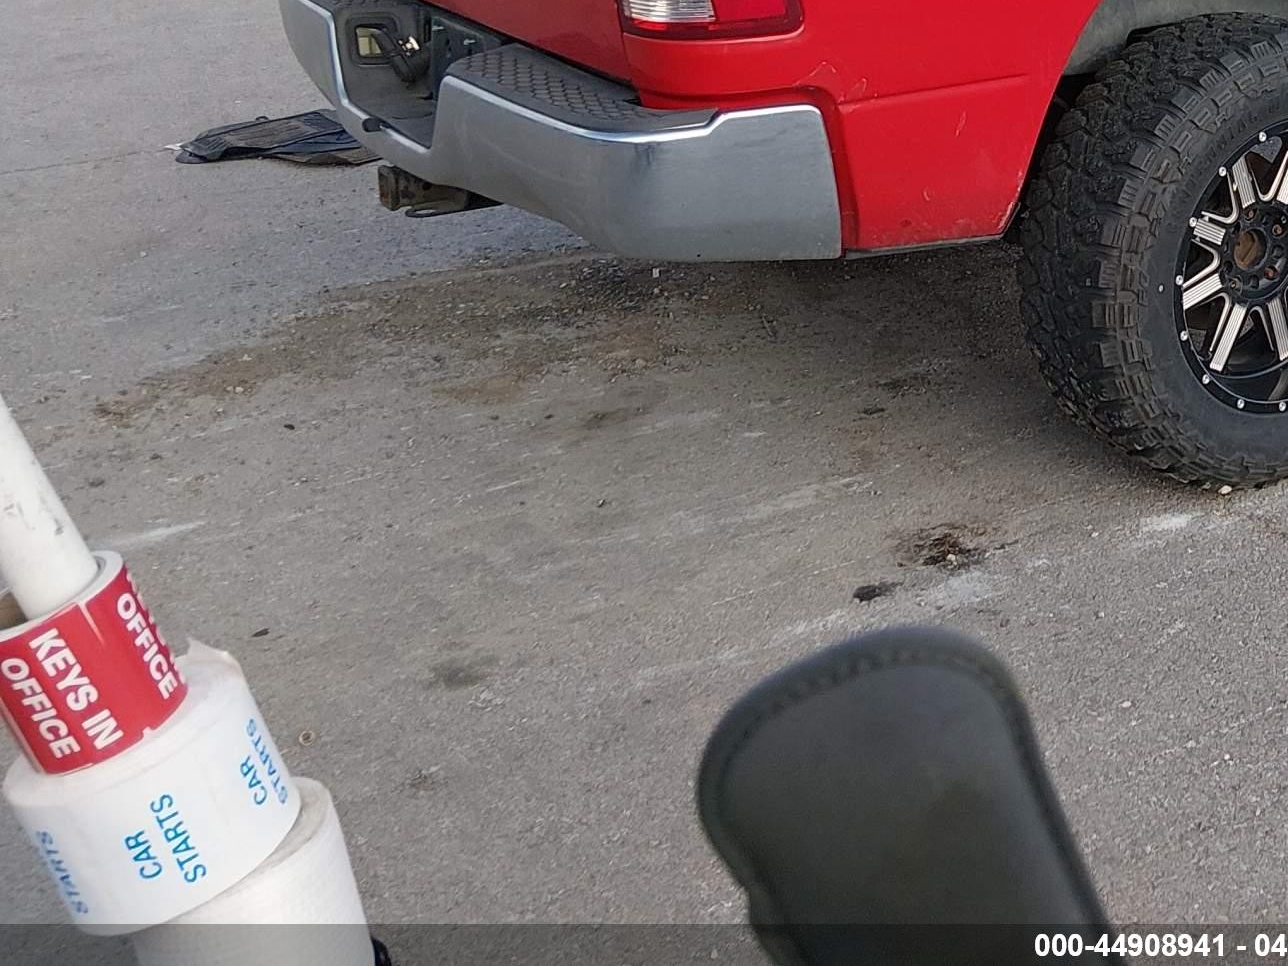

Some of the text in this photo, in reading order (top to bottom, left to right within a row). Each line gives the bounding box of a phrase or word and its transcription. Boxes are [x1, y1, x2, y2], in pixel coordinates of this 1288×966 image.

[28, 627, 124, 751] KEYS IN
[117, 592, 179, 700] OFFICE
[1, 657, 81, 759] OFFICE
[239, 754, 268, 805] CAR
[124, 829, 163, 880] CAR
[150, 793, 207, 883] STARTS
